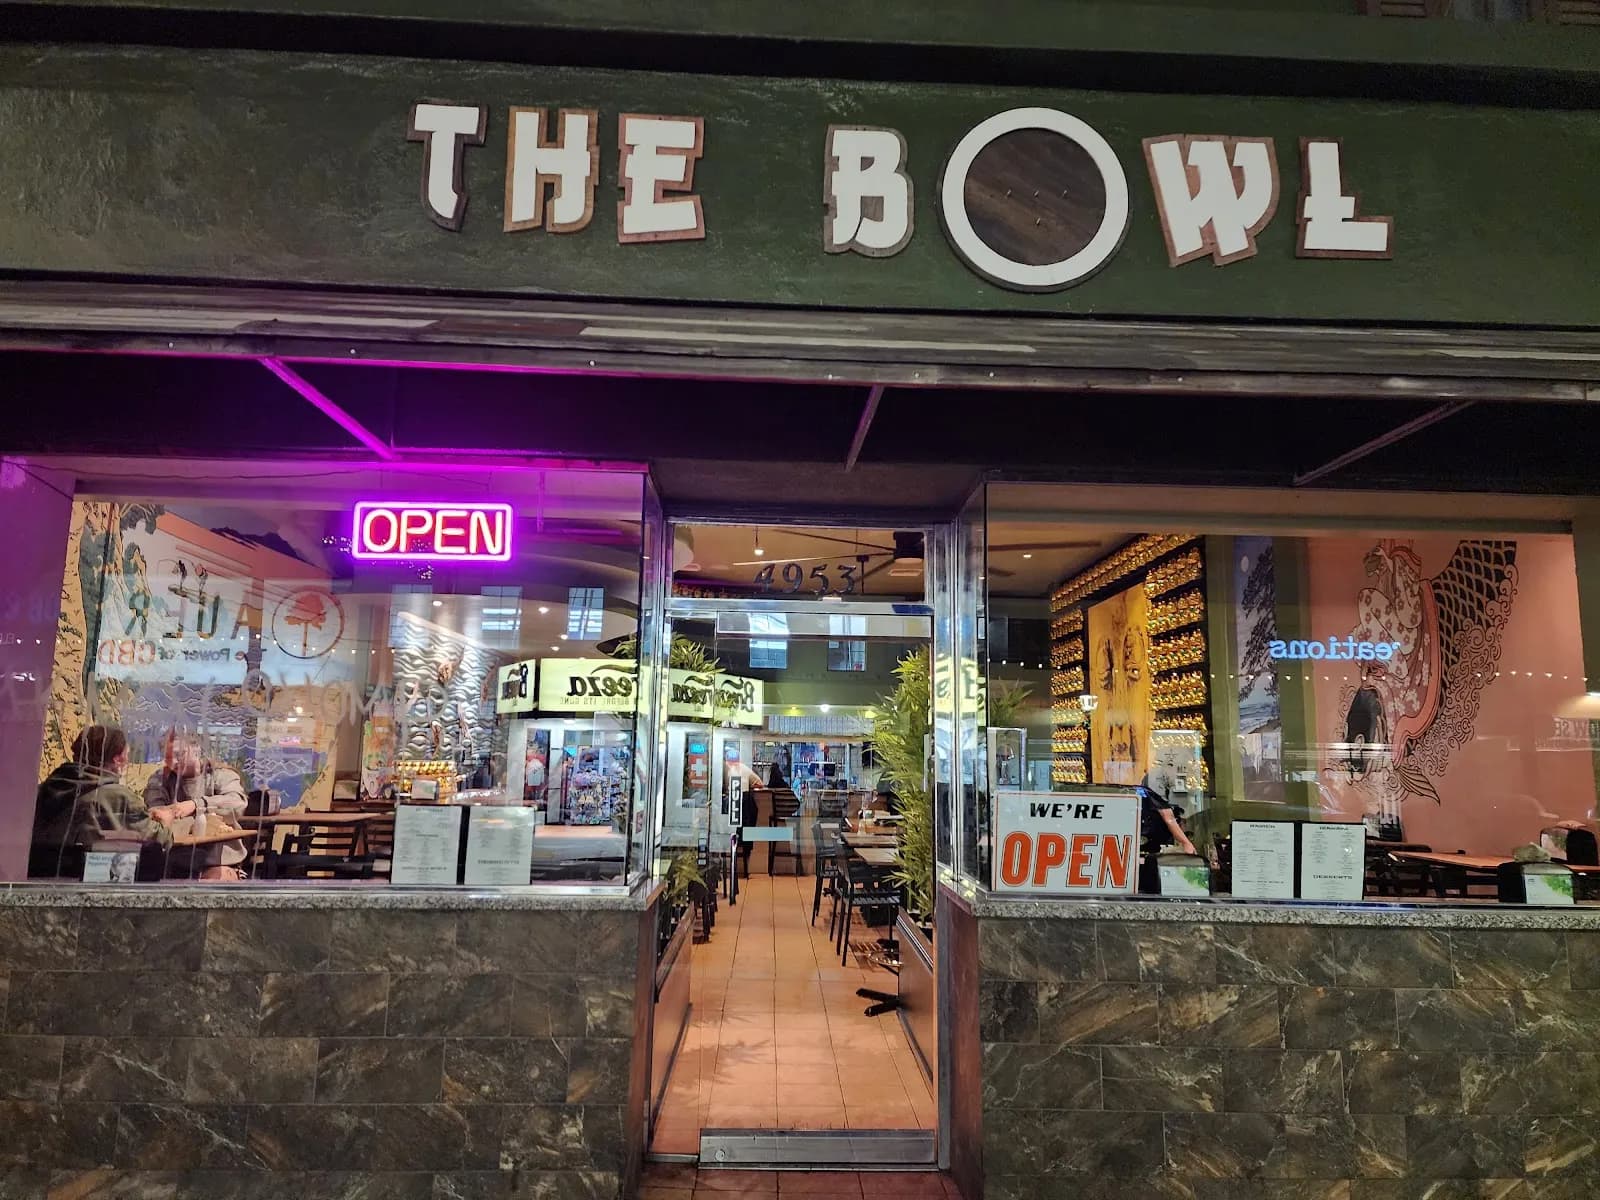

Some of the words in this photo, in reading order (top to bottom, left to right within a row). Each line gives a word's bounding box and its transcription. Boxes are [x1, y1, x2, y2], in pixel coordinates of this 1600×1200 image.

[409, 102, 704, 241] THE
[826, 107, 1391, 290] BOWL
[363, 508, 503, 554] OPEN
[753, 563, 857, 600] 4953
[731, 780, 740, 823] PULL
[1030, 803, 1104, 819] WE'RE
[1001, 831, 1132, 888] OPEN
